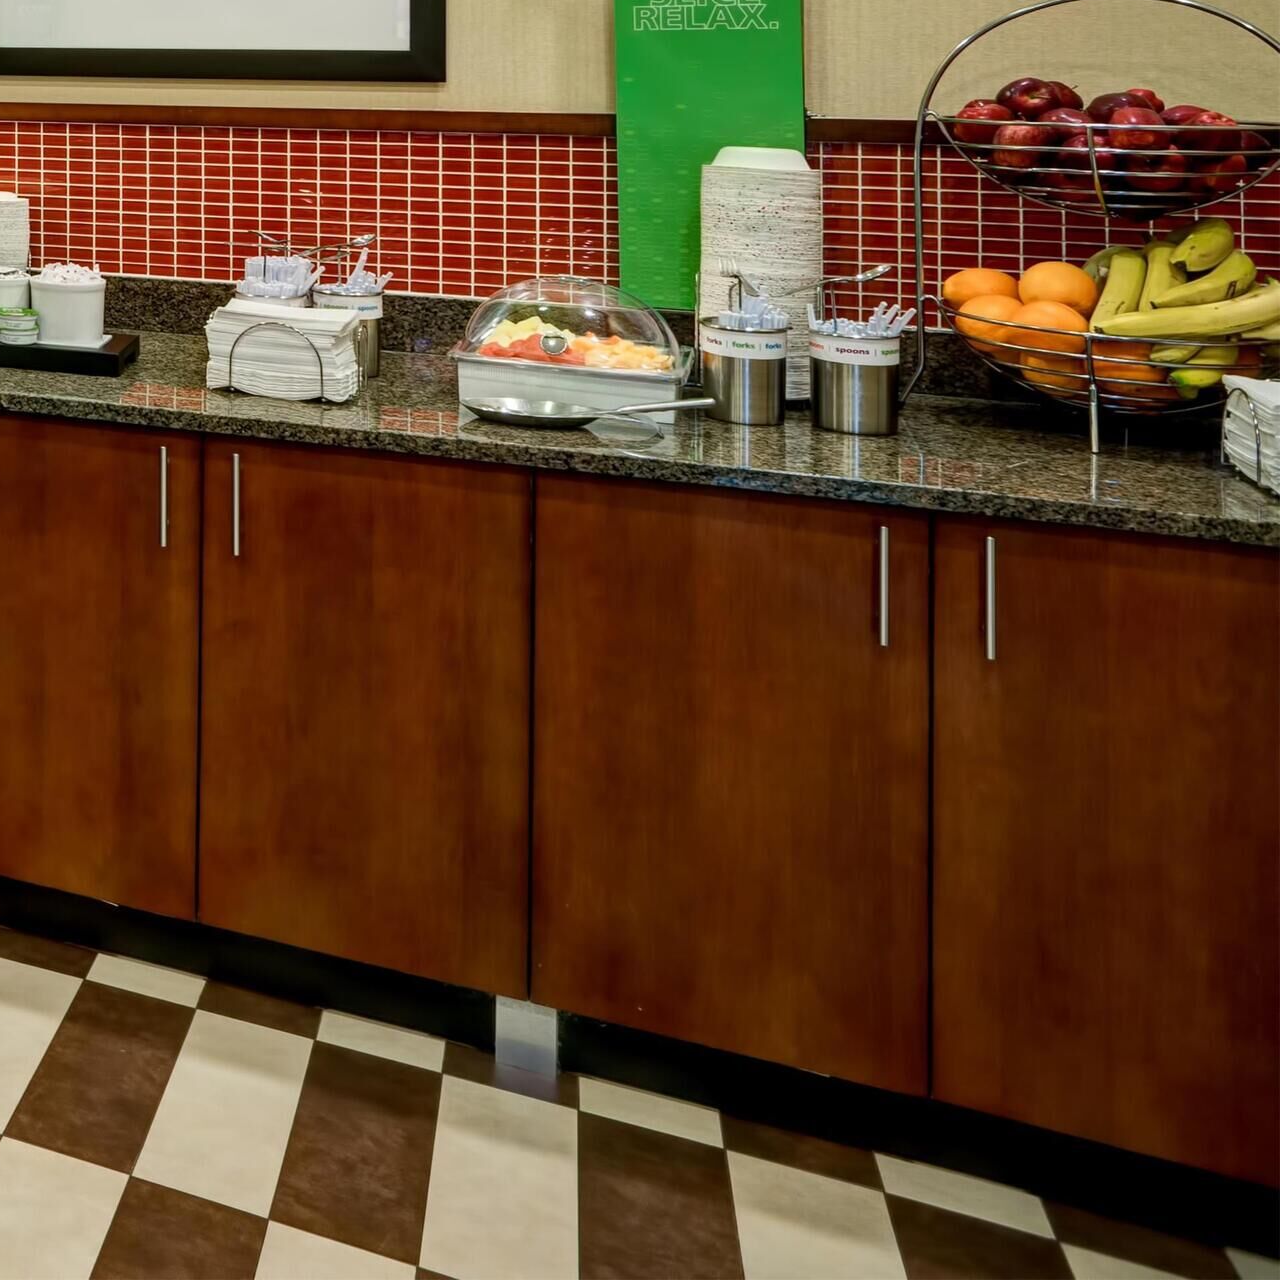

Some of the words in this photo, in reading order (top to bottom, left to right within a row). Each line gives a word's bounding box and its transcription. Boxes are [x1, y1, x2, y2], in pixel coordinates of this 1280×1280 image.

[632, 3, 780, 32] RELAX.
[732, 341, 756, 350] forks
[835, 346, 870, 356] spoons
